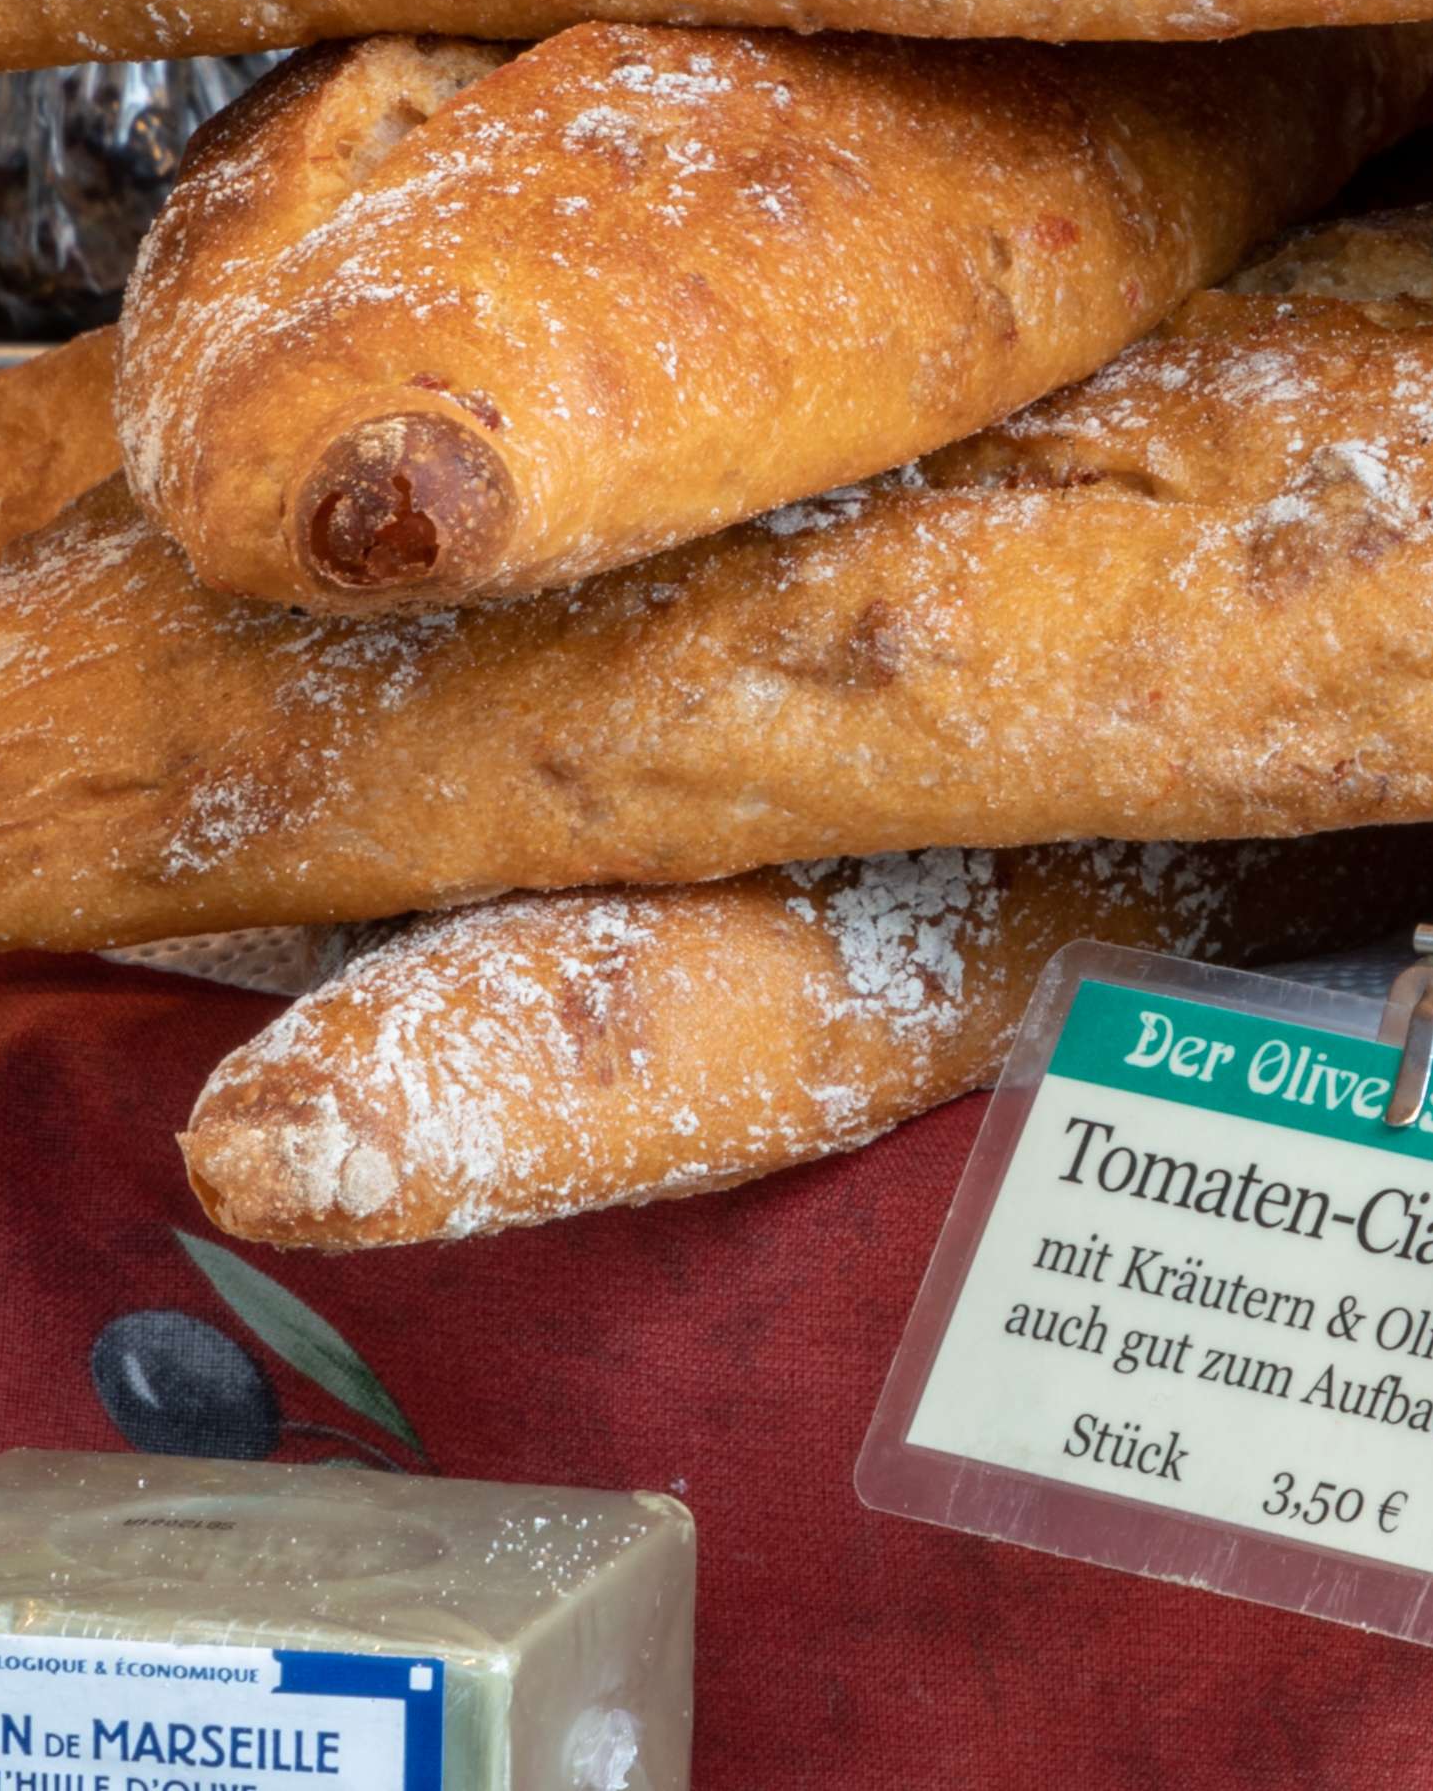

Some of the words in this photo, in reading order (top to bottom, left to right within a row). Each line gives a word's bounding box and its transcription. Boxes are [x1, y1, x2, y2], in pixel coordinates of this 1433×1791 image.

[1126, 1011, 1235, 1082] Der
[1033, 1233, 1113, 1283] mit
[1118, 1246, 1315, 1330] Kräutern
[1326, 1295, 1366, 1342] &
[1004, 1303, 1109, 1354] auch
[1112, 1330, 1193, 1374] gut
[1197, 1349, 1293, 1399] zum
[1063, 1413, 1189, 1482] Stück
[1262, 1472, 1365, 1525] 3,50
[1378, 1491, 1409, 1533] €
[94, 1660, 108, 1675] &
[116, 1658, 261, 1684] ÉCONOMIQUE
[44, 1733, 82, 1759] DE
[93, 1719, 341, 1775] MARSEILLE
